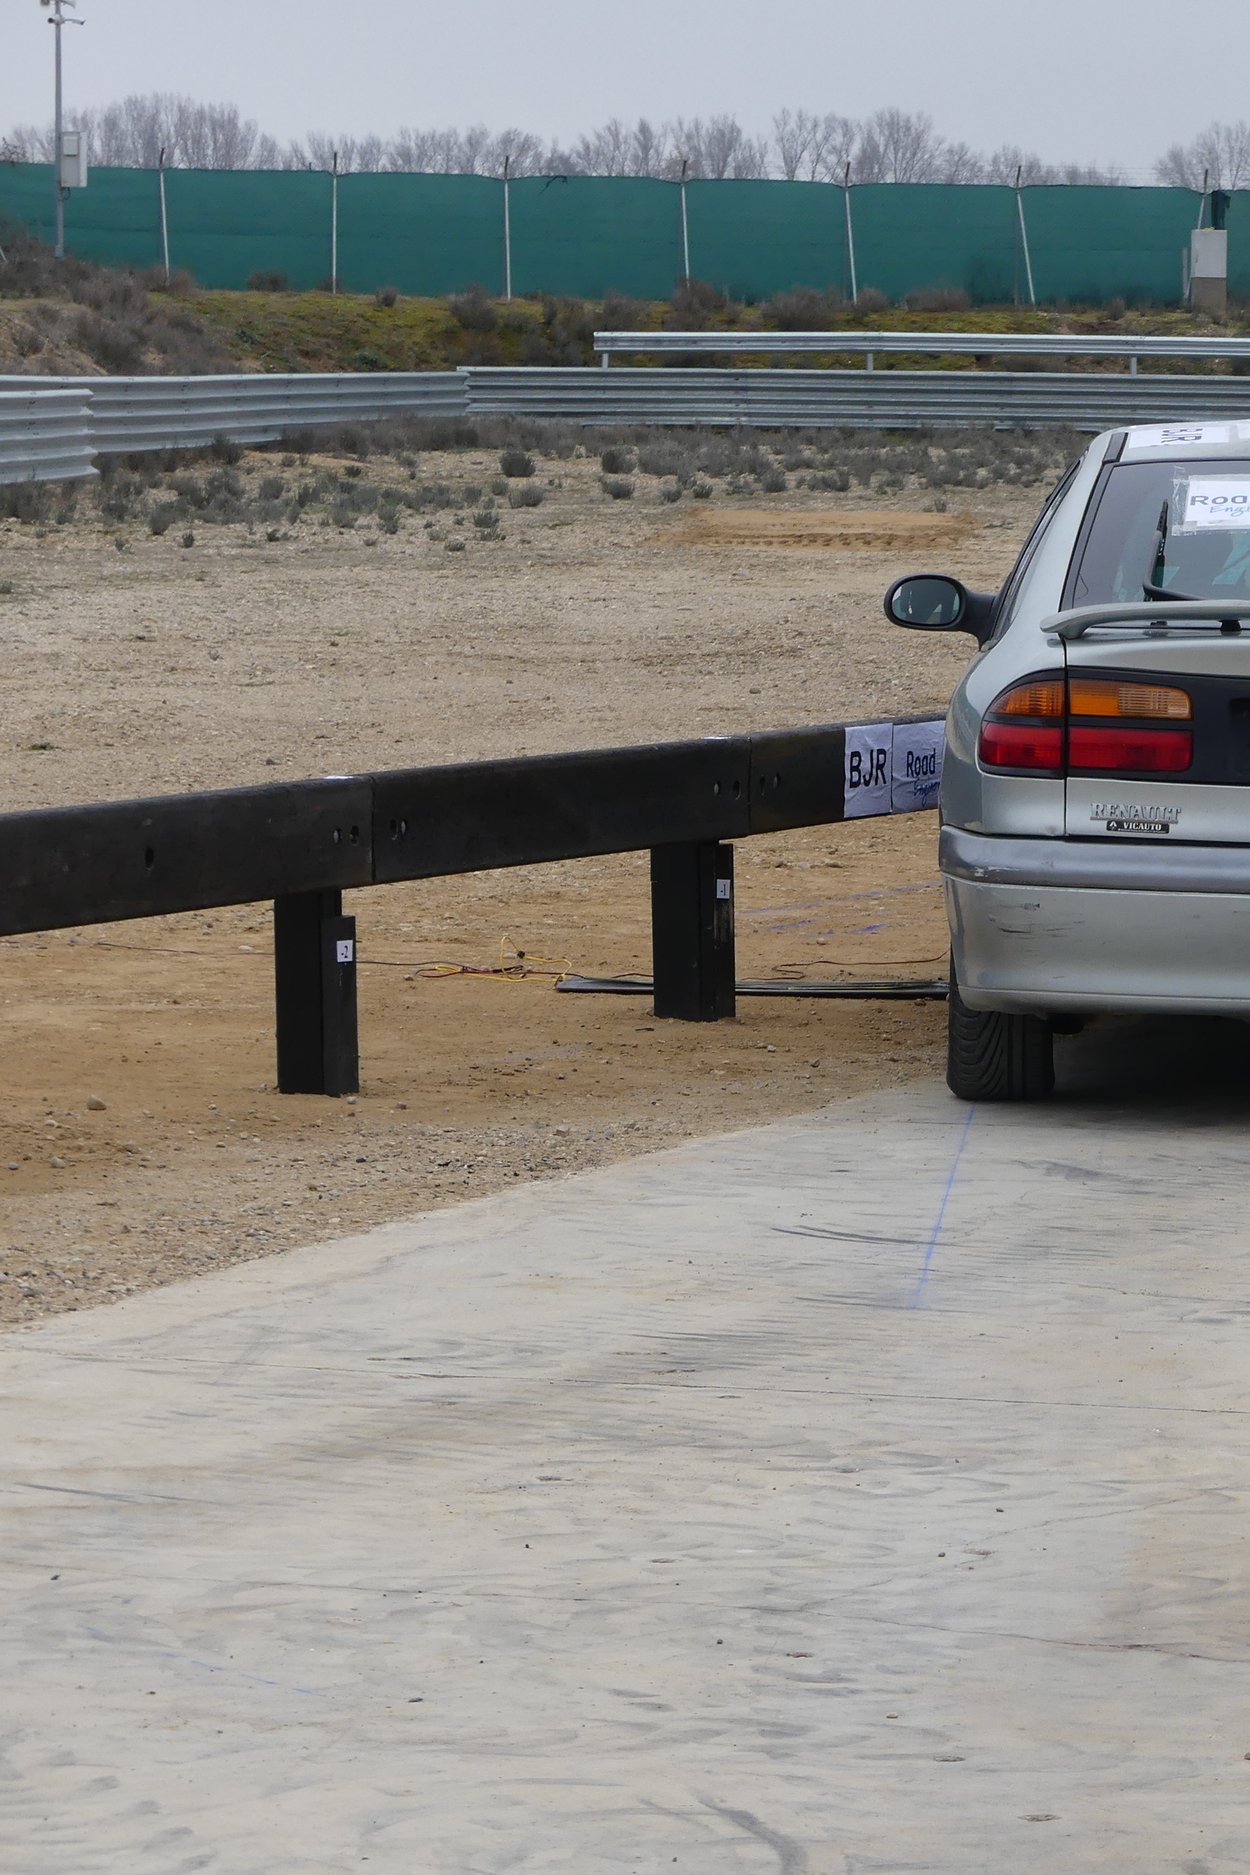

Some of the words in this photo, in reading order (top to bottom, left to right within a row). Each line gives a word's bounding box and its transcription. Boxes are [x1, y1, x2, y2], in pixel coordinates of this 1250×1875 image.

[849, 748, 887, 789] BJR
[906, 747, 936, 778] Road
[1090, 802, 1182, 822] RENAULT
[1123, 822, 1162, 831] VICAUTO
